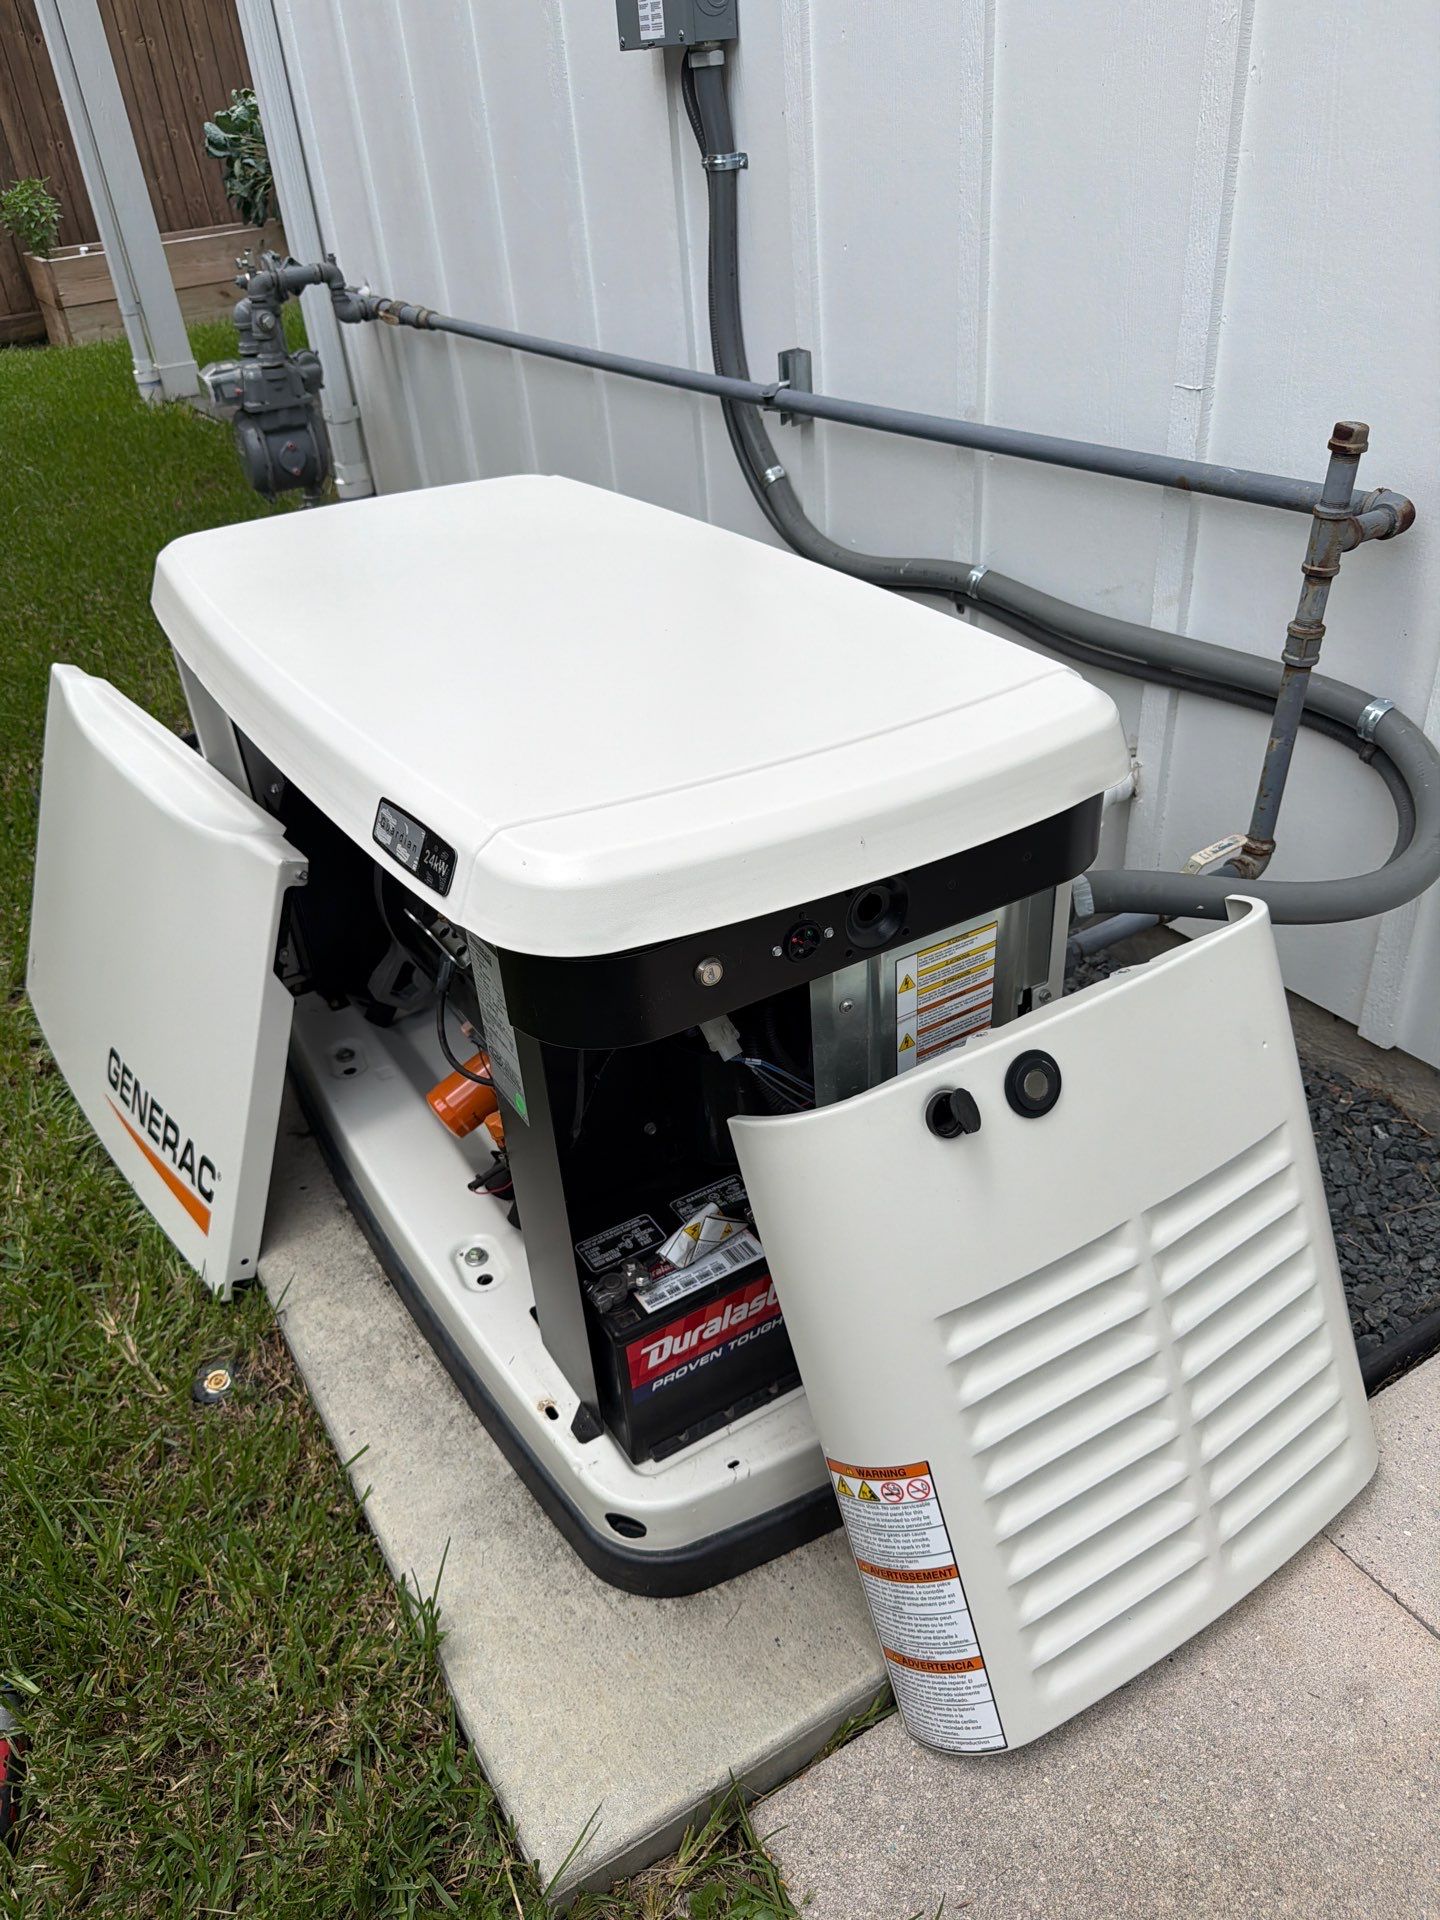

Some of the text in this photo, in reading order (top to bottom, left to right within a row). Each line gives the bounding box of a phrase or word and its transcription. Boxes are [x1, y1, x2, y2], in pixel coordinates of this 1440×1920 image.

[380, 816, 417, 852] Guardian
[424, 850, 448, 876] 24kW
[108, 1046, 216, 1204] GENERAC
[640, 1283, 778, 1370] Duralast
[652, 1316, 783, 1392] PROVEN TOUGH
[856, 1468, 907, 1479] WARNING
[902, 1502, 930, 1510] serviceable
[870, 1567, 953, 1580] AVERTISSEMENT
[902, 1658, 974, 1671] ADVERTENCIA
